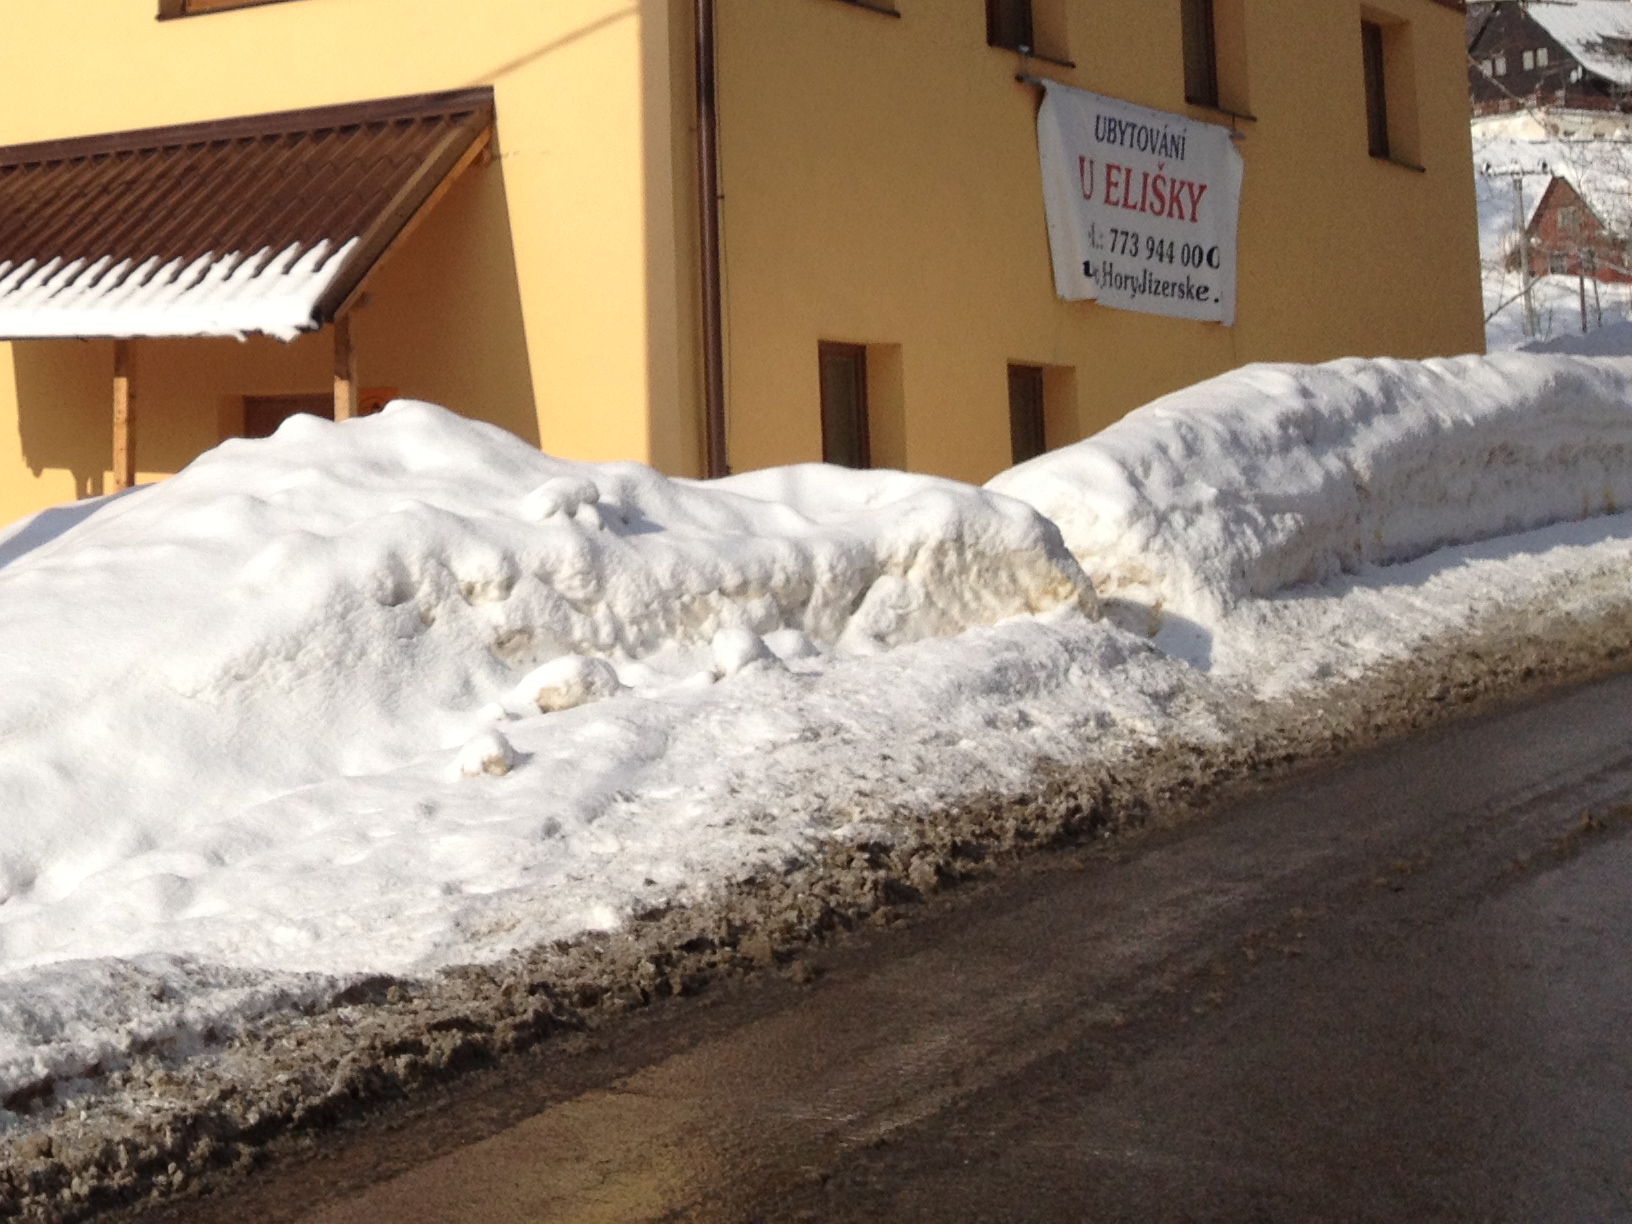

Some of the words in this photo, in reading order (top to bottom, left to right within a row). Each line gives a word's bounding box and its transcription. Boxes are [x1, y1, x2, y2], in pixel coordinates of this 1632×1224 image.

[1094, 114, 1187, 161] UBYTOVÁNÍ
[1078, 155, 1094, 201] U
[1103, 160, 1207, 223] ELIŠKY
[1109, 227, 1139, 258] 773
[1145, 235, 1175, 265] 944
